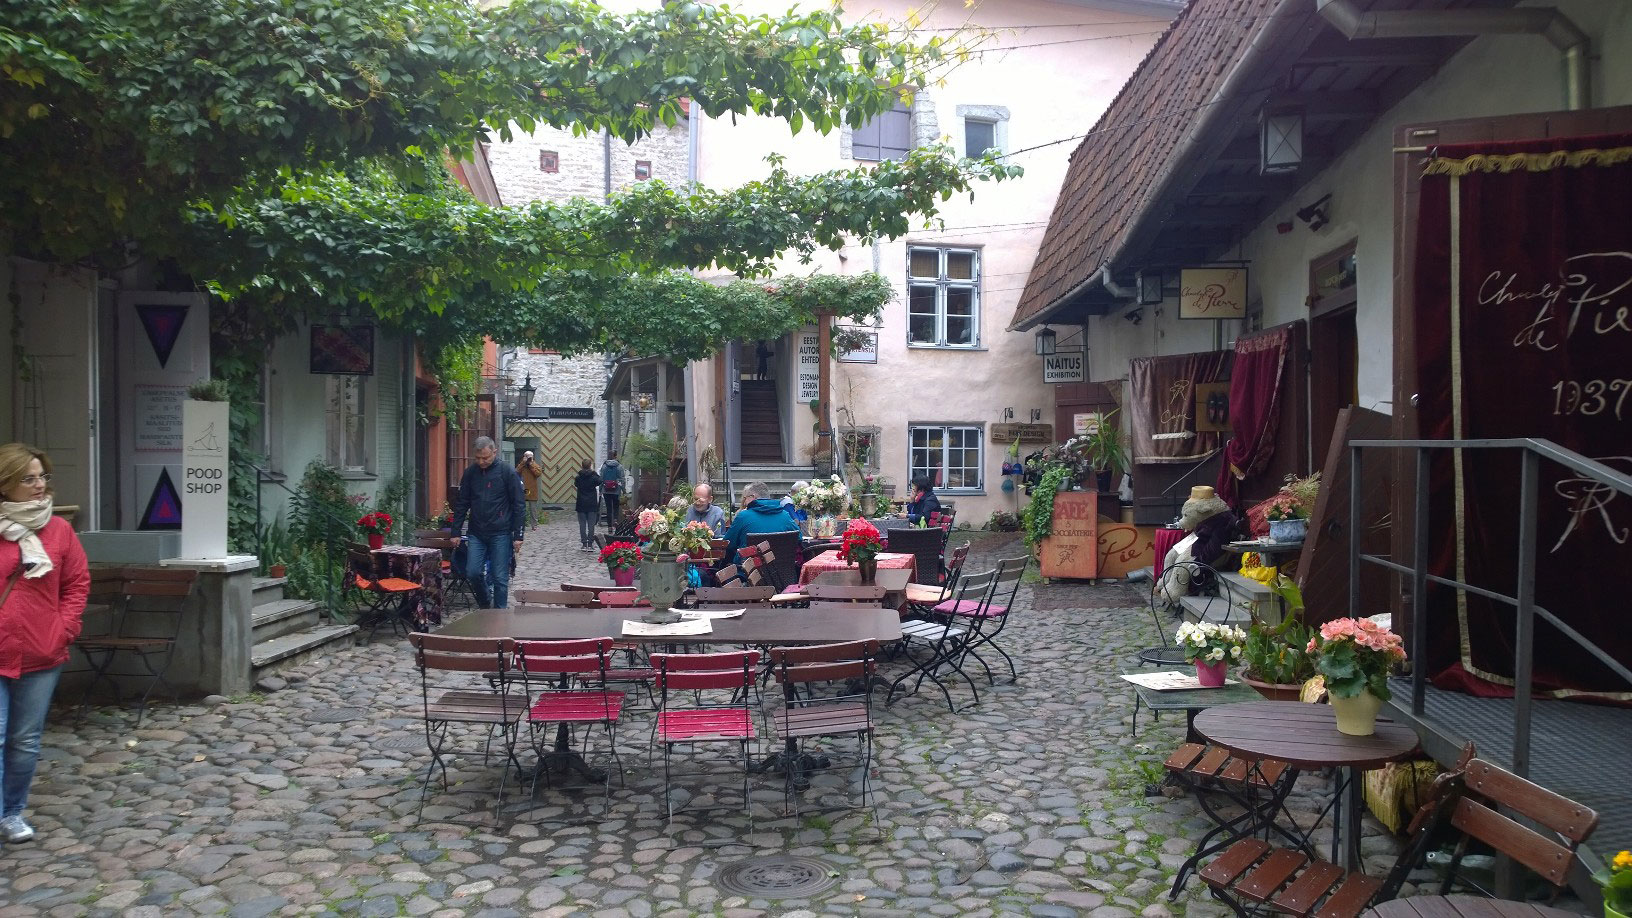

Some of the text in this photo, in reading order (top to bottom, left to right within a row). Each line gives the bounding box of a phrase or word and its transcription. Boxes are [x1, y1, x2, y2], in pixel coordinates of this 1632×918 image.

[799, 346, 820, 355] AUTOR
[801, 356, 820, 364] EHTED
[1046, 355, 1081, 370] NÄITUS
[1046, 371, 1081, 379] EXHIBITION
[801, 390, 819, 398] JEWELRY
[1552, 379, 1632, 421] 1937
[186, 467, 223, 479] POOD
[186, 482, 222, 494] SHOP
[1052, 529, 1094, 537] OCOLATERIE
